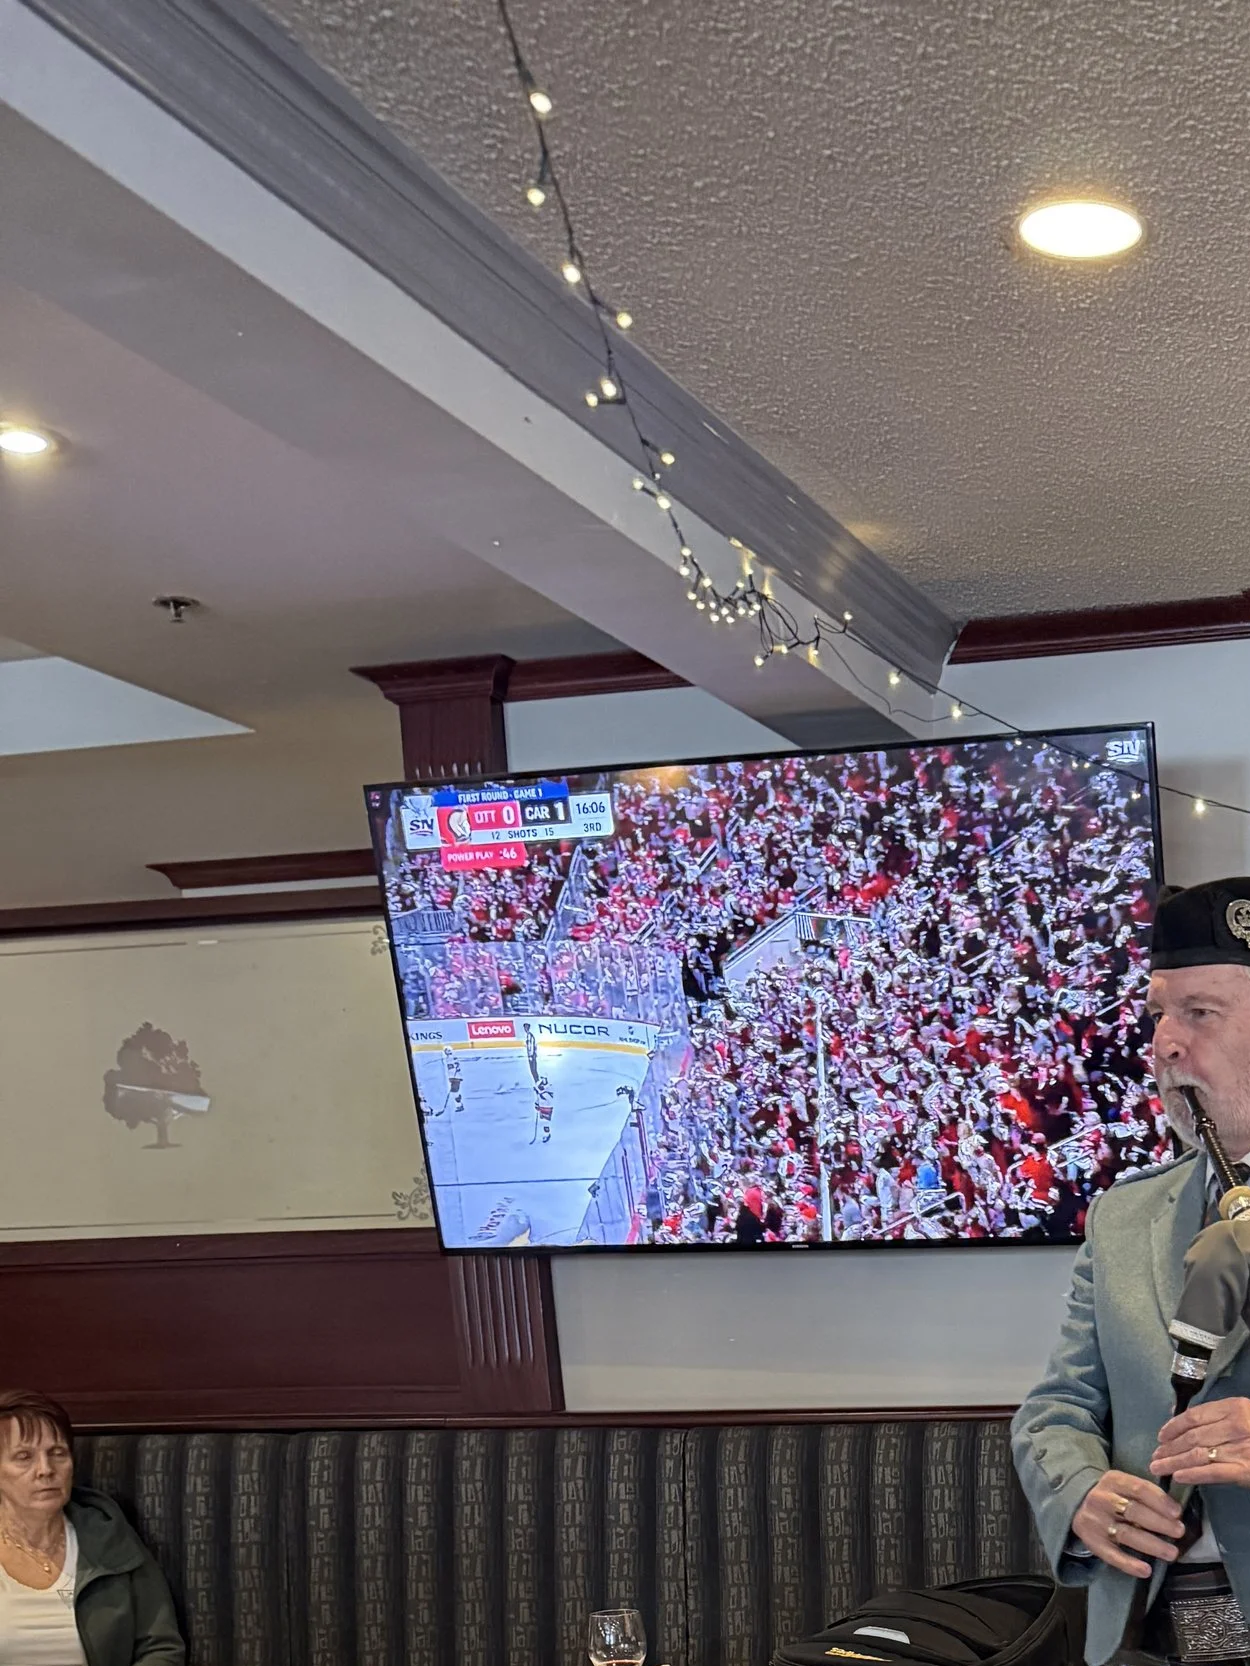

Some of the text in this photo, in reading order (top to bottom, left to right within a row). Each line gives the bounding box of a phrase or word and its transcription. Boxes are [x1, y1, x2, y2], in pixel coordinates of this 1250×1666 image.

[458, 788, 543, 803] FIRST ROUND GAME 1
[525, 802, 565, 820] CAR 1
[576, 802, 606, 814] 16:06
[474, 806, 515, 824] OTT 0
[410, 819, 433, 830] SN
[583, 823, 602, 832] 3RD
[492, 828, 554, 840] 12 SHOTS 15
[447, 852, 474, 861] POWER
[475, 851, 494, 859] PLAY
[472, 1025, 512, 1035] Lenovo
[538, 1024, 610, 1036] NUCOR
